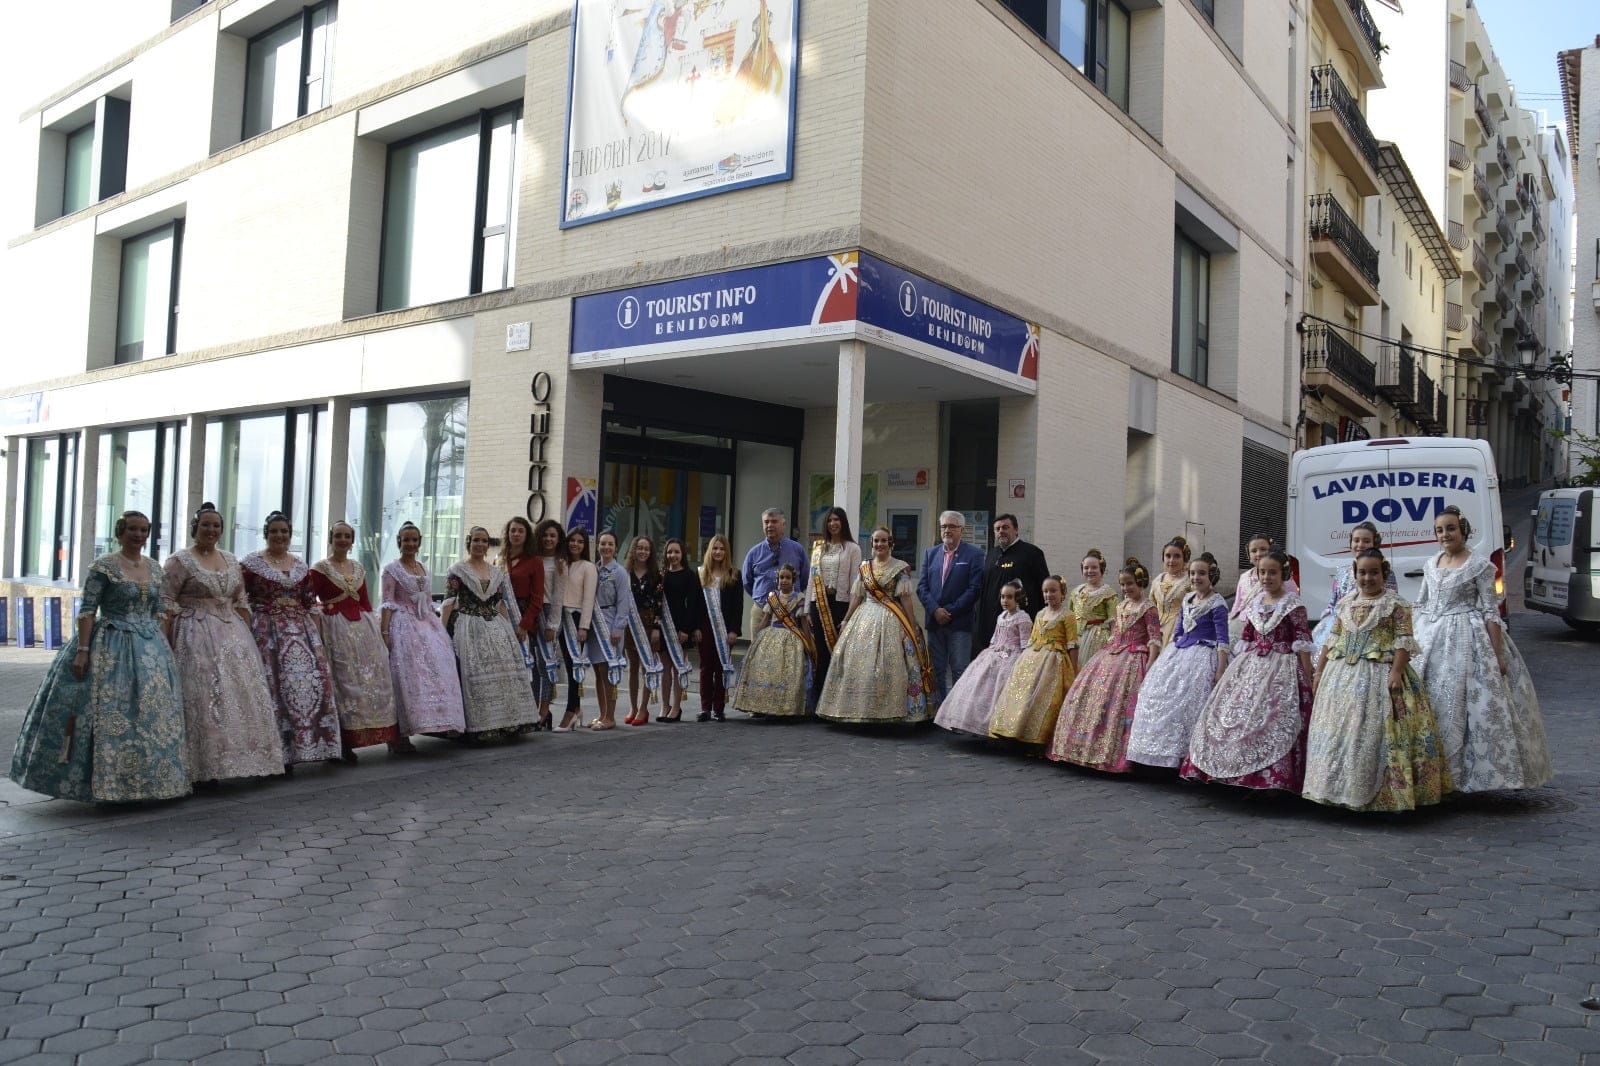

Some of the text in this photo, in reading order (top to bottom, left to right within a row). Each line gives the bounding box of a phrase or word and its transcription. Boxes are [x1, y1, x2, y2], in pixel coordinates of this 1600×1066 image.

[646, 291, 712, 318] TOURIST
[716, 285, 756, 309] INFO
[921, 295, 967, 328] TOURIST
[969, 316, 992, 339] INFO
[656, 311, 744, 335] BENIDORM
[928, 323, 985, 354] BENIDORM
[1312, 472, 1476, 500] LAVANDERIA
